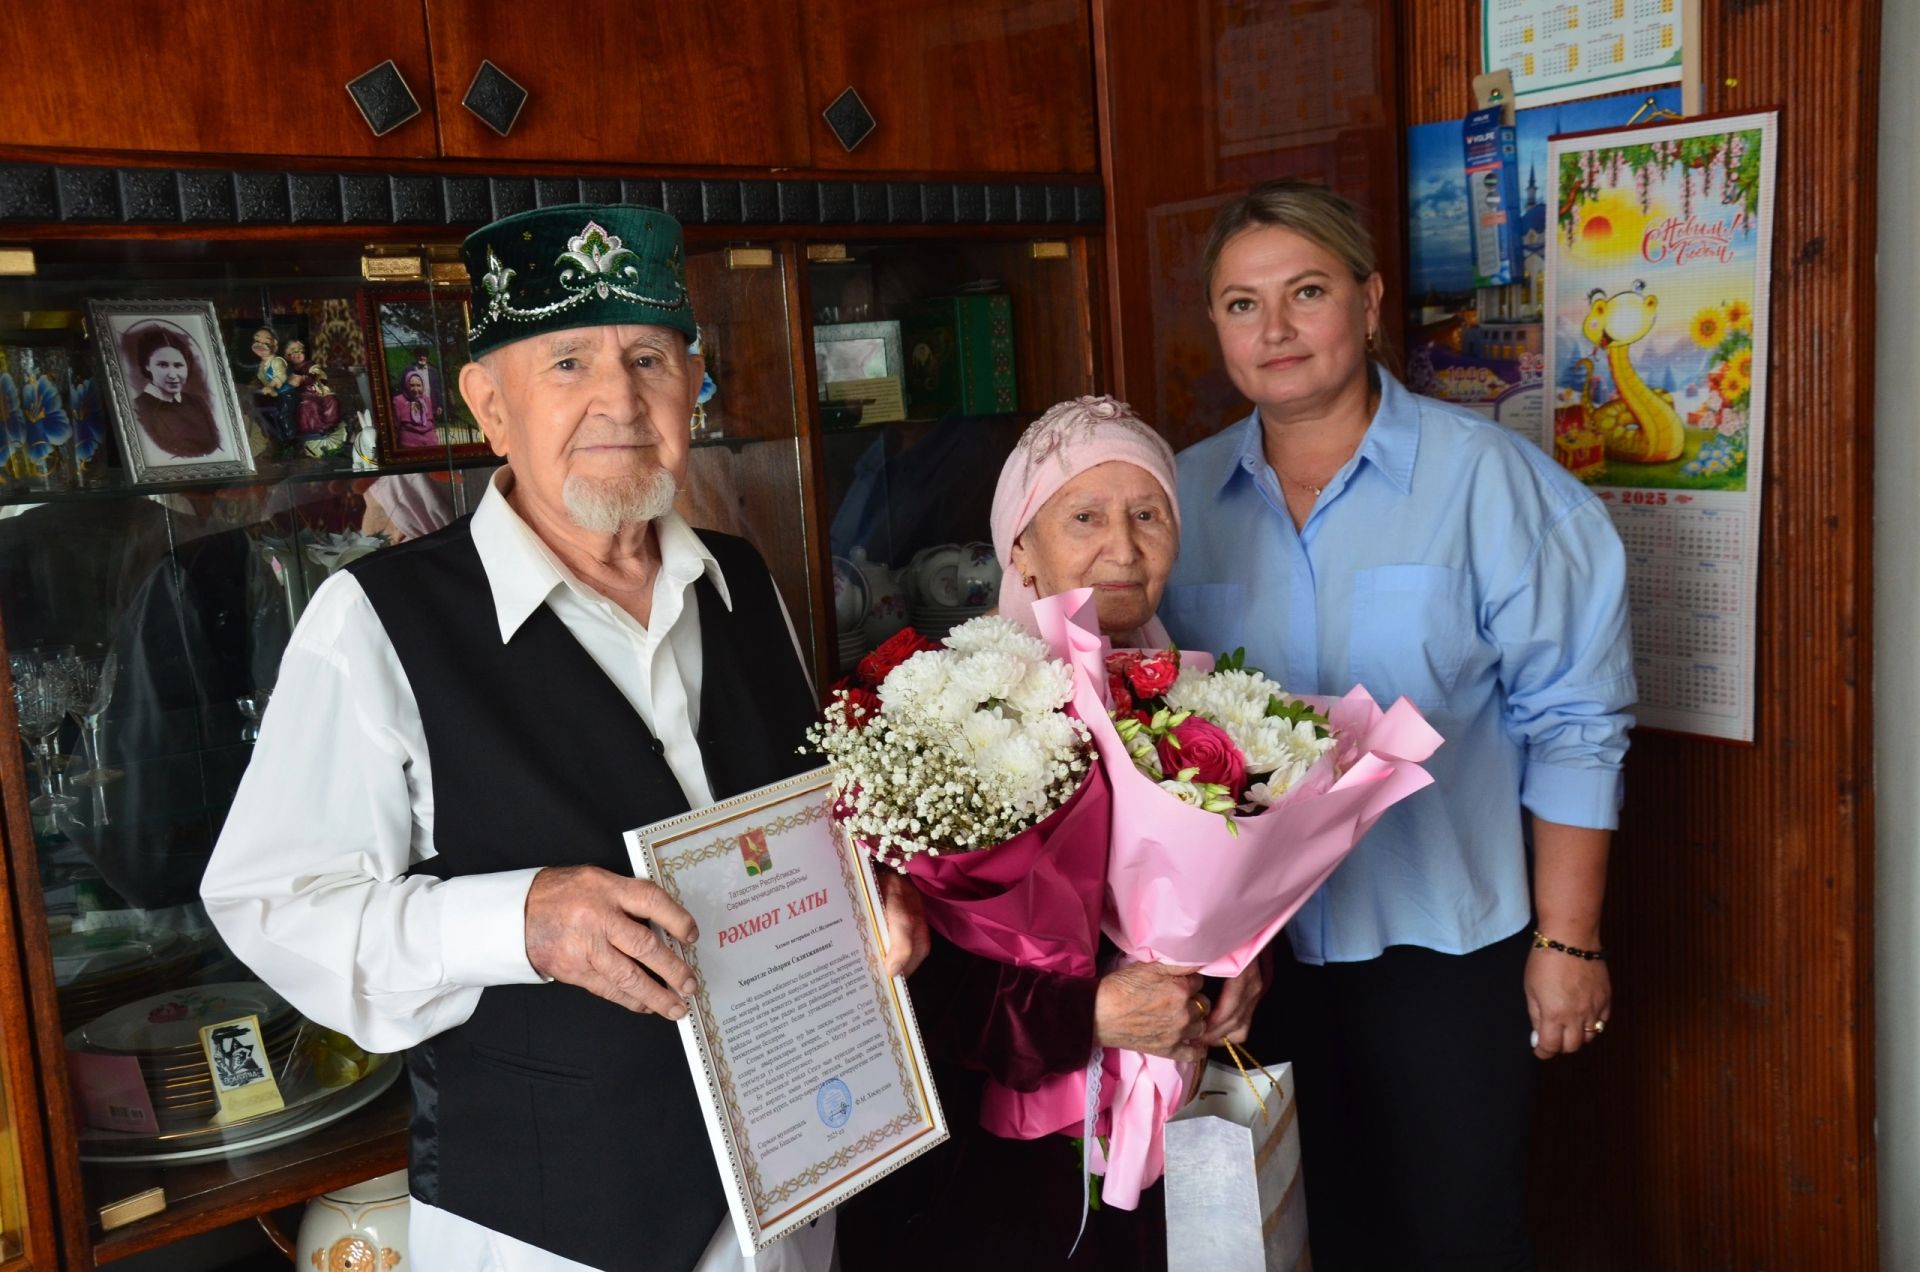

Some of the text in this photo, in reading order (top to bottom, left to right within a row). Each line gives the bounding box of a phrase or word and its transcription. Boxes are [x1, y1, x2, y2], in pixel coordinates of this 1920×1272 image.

[1622, 491, 1668, 506] 2025
[726, 874, 807, 911] Сарман муниципаль районы
[728, 867, 800, 899] Татарстан Республикасы
[719, 888, 827, 947] РӘХМӘТ ХАТЫ
